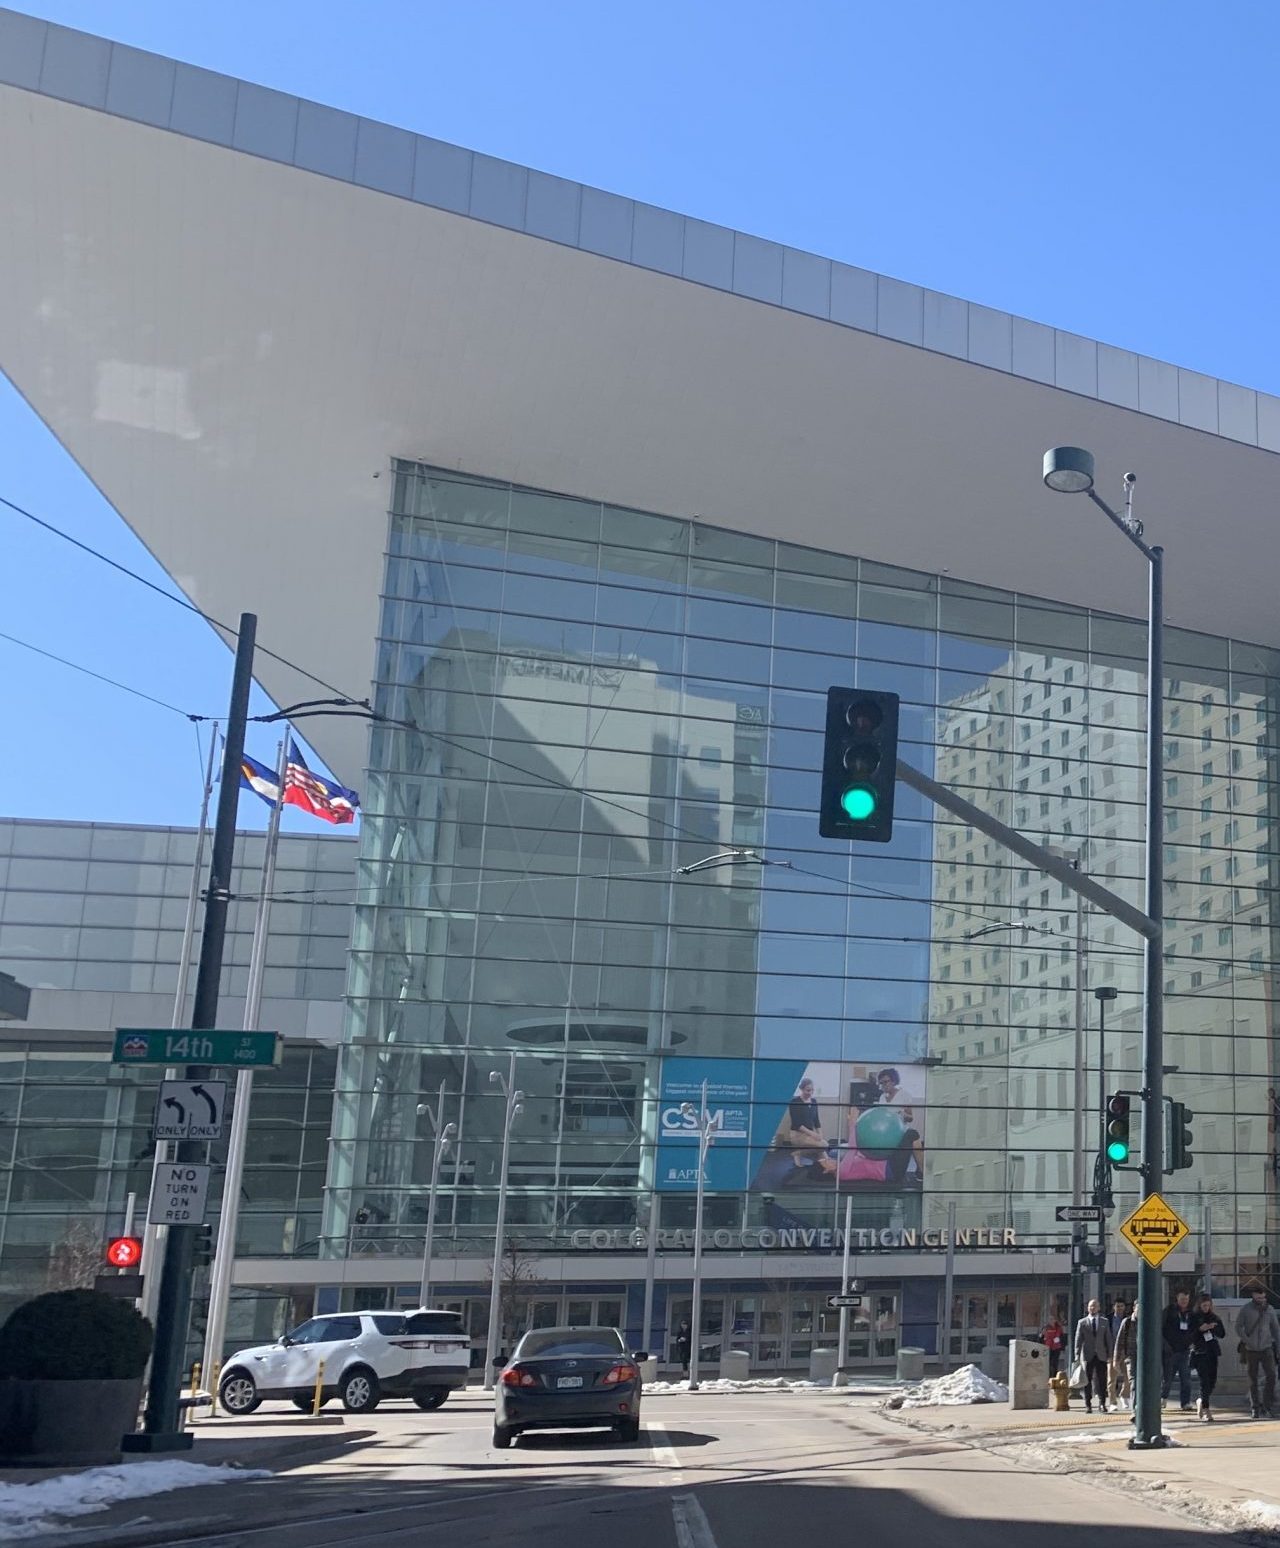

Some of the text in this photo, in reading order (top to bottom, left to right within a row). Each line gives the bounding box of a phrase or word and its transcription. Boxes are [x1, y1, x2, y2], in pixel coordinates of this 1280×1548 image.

[164, 1035, 213, 1058] 14th
[662, 1107, 724, 1130] CSM
[157, 1126, 220, 1136] ONLY ONLY
[170, 1169, 196, 1181] NO
[166, 1183, 198, 1194] TURN
[170, 1197, 188, 1207] ON
[166, 1210, 190, 1220] RED
[570, 1227, 1017, 1249] COLORADO CONVENTION CENTER
